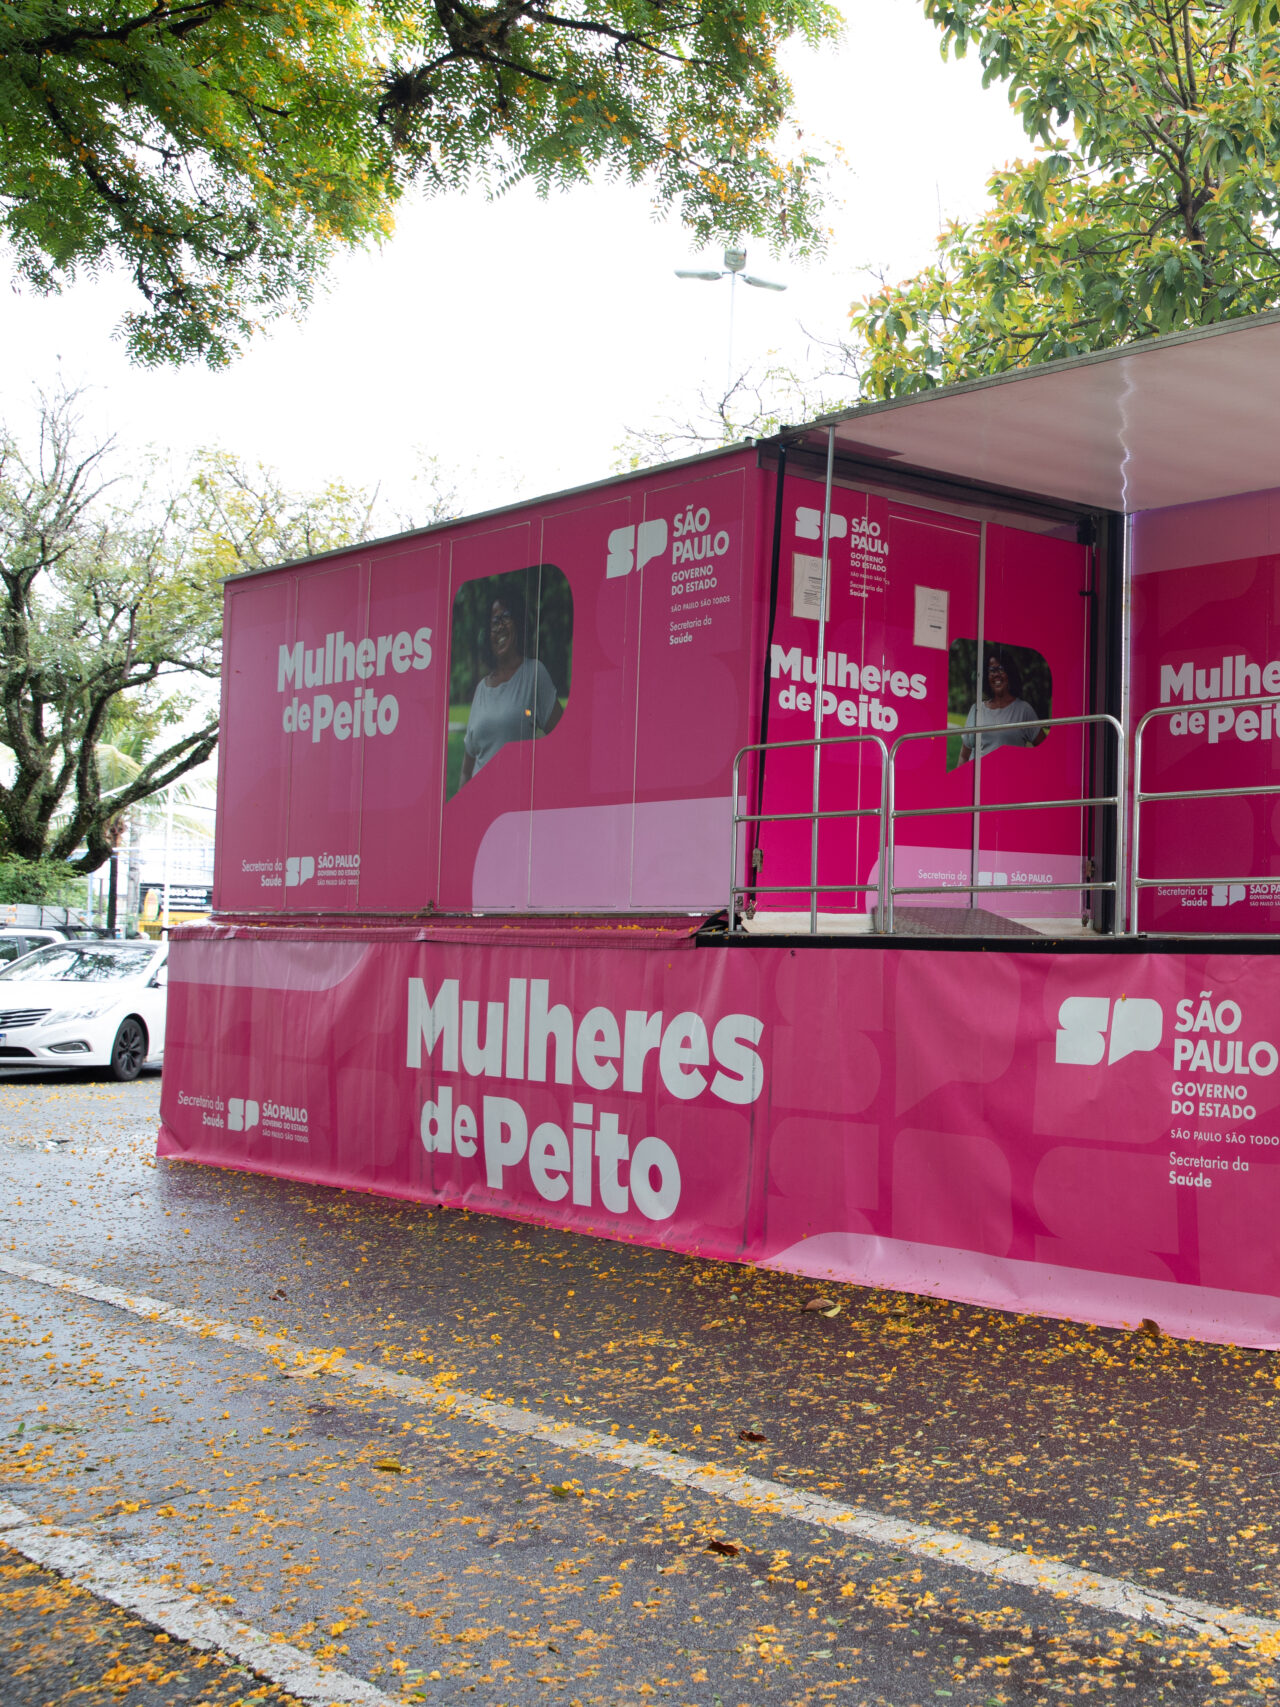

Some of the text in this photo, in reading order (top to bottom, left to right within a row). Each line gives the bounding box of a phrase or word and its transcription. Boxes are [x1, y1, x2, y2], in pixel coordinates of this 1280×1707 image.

[673, 504, 711, 538] SÃO
[851, 516, 881, 537] SÃO
[606, 518, 668, 579] SP
[672, 530, 730, 565] PAULO
[850, 552, 884, 564] GOVERNO
[850, 560, 887, 573] DO ESTADO
[671, 565, 713, 583] GOVERNO
[671, 577, 718, 596] DO ESTADO
[669, 615, 712, 632] Secretaria da
[669, 631, 693, 646] Saúde
[277, 627, 433, 692] Mulheres
[770, 644, 928, 700] Mulheres
[283, 686, 399, 743] de Peito
[778, 685, 899, 732] de Peito
[1169, 710, 1206, 736] de
[242, 859, 273, 872] Secretaria
[318, 852, 360, 868] SÃO PAULO
[261, 874, 282, 887] Saúde
[285, 856, 315, 887] SP
[918, 869, 967, 881] Secretaria da
[1011, 871, 1053, 883] SÃO PAULO
[1157, 885, 1208, 896] Secretaria da
[1181, 897, 1208, 907] Saúde
[1174, 990, 1242, 1034] SÃO
[406, 977, 765, 1104] Mulheres
[1055, 996, 1163, 1066] SP
[1173, 1038, 1279, 1076] PAULO
[1171, 1081, 1248, 1100] GOVERNO
[177, 1090, 224, 1111] Secretaria da
[202, 1112, 224, 1128] Saúde
[227, 1097, 259, 1132] SP
[262, 1099, 308, 1123] SÃO PAULO
[1171, 1101, 1256, 1120] DO ESTADO
[1170, 1128, 1191, 1140] SÃO
[1193, 1131, 1222, 1142] PAULO
[1226, 1132, 1246, 1144] SÃO
[420, 1086, 682, 1222] de Peito
[1169, 1152, 1249, 1171] Secretaria da
[1169, 1171, 1212, 1188] Saúde
